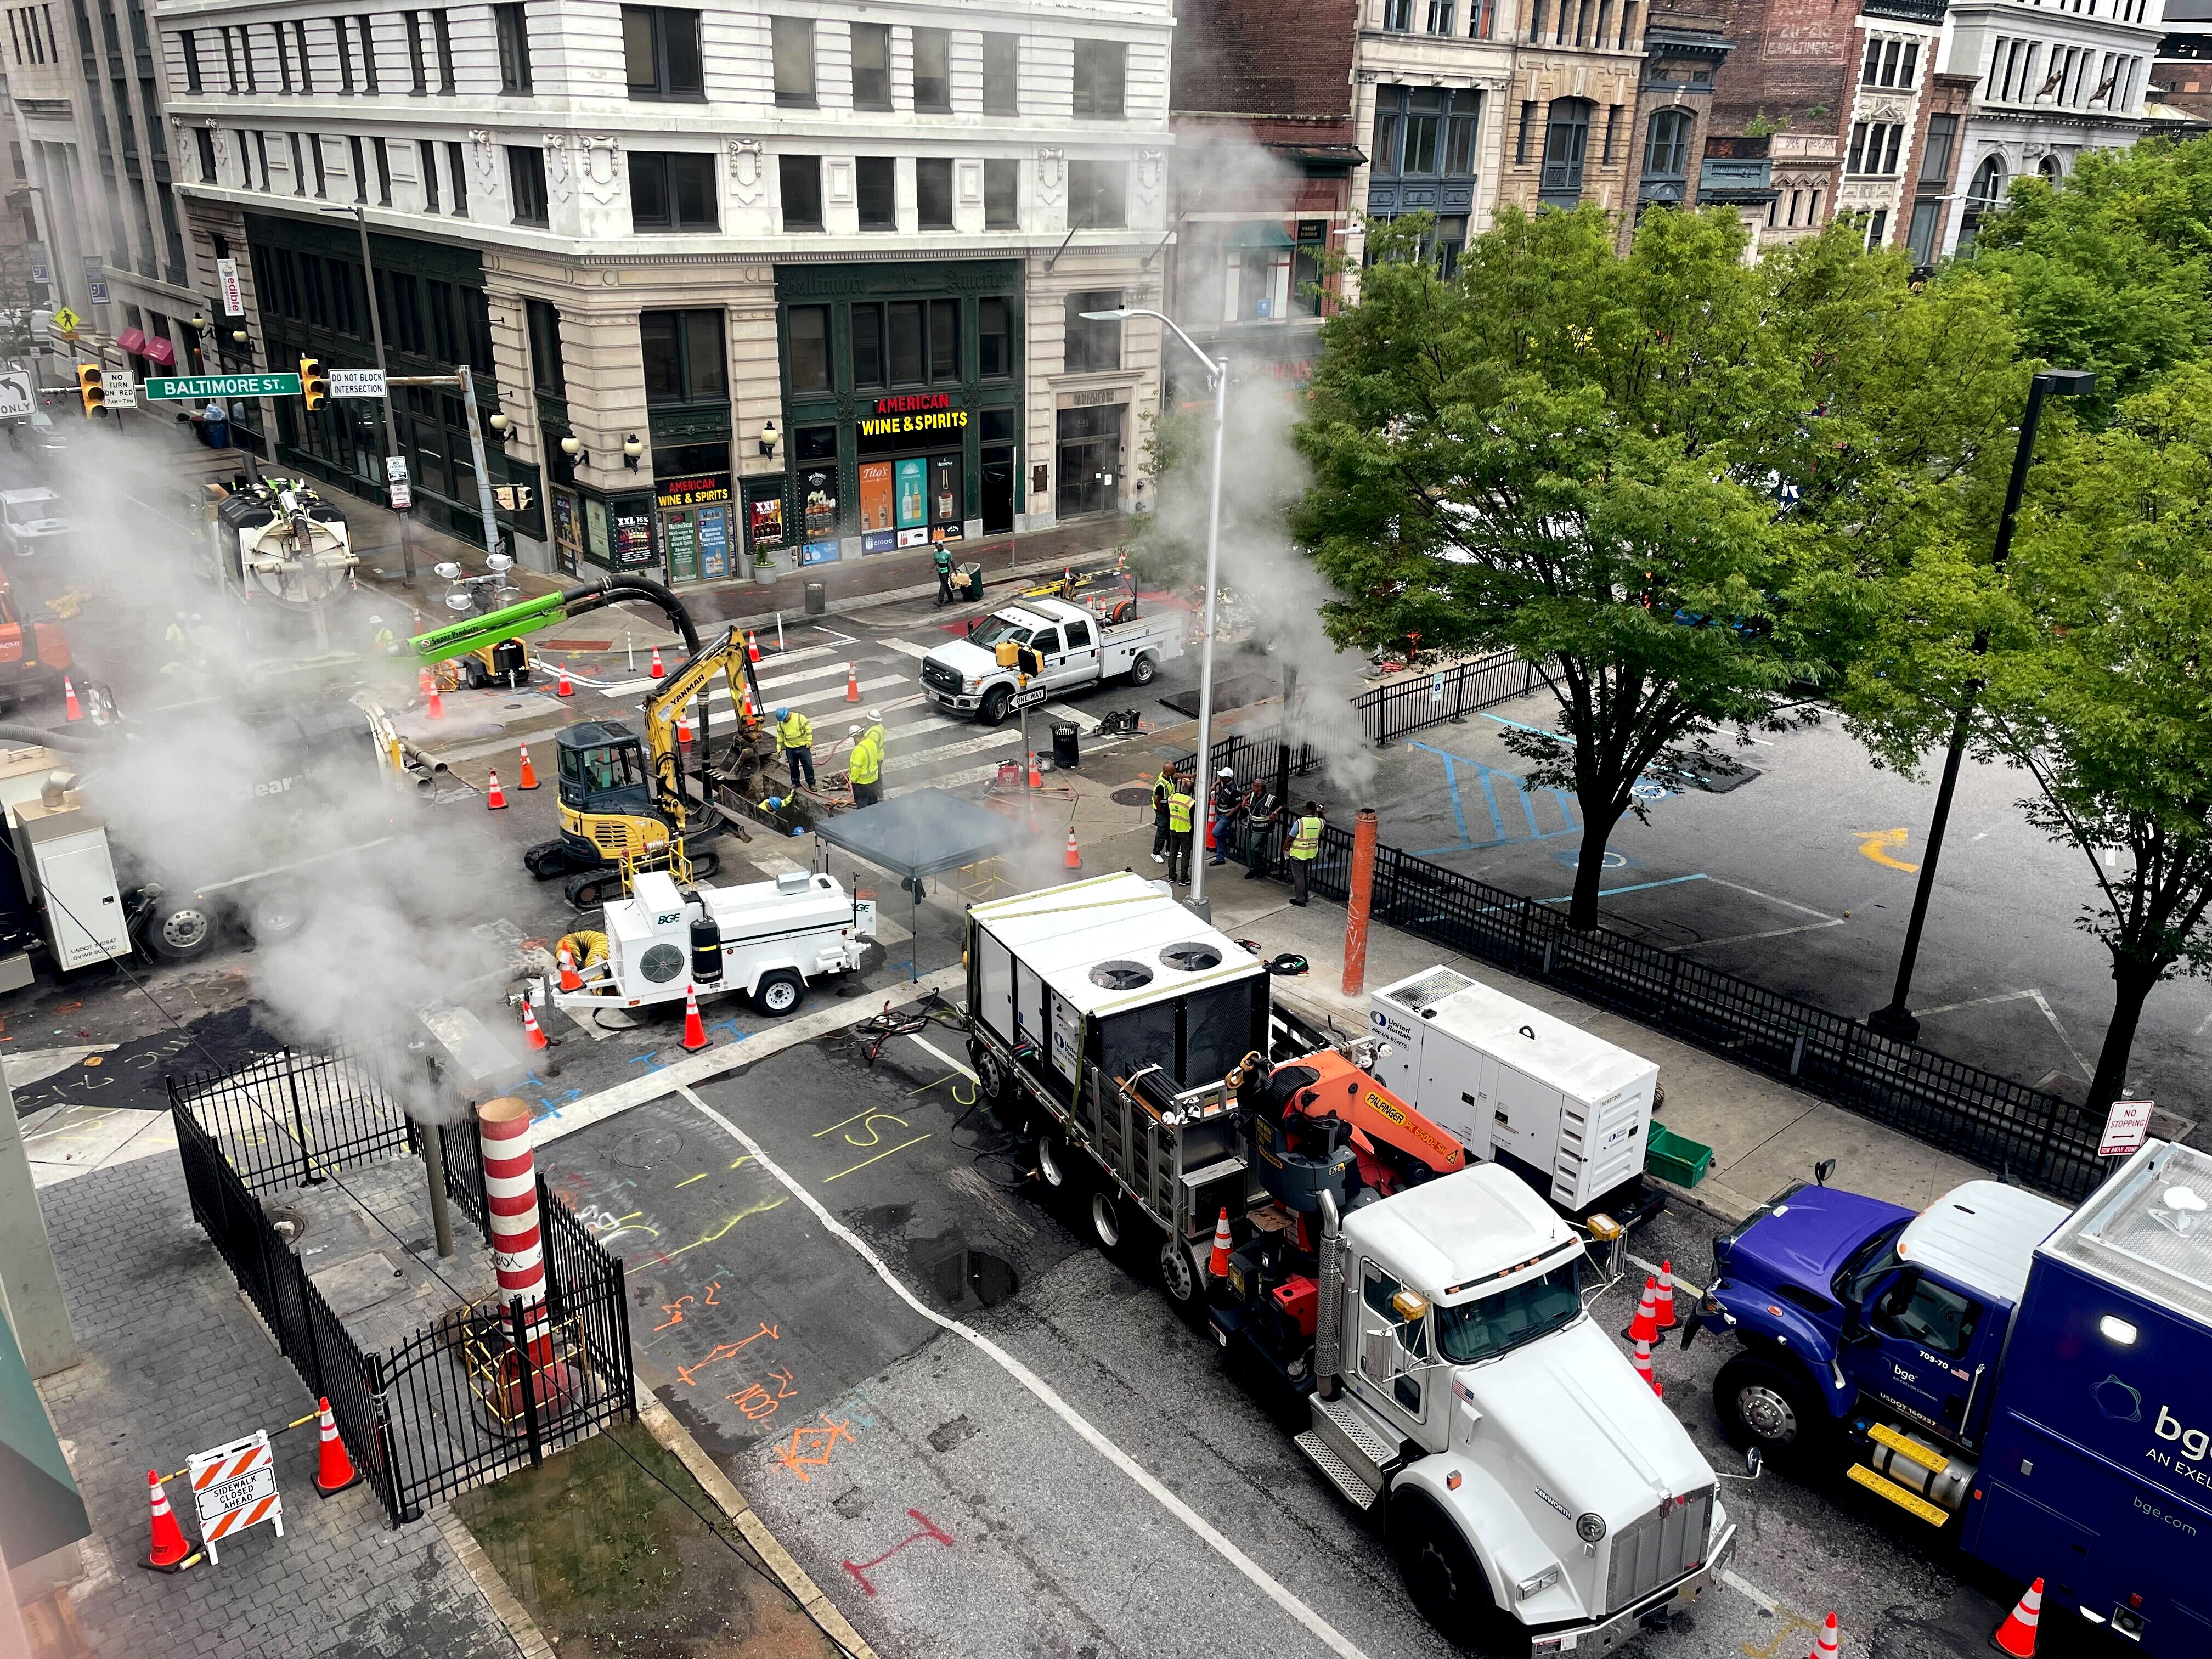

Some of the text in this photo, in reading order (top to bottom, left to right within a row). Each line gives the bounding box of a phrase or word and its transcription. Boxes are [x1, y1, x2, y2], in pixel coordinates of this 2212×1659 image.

[228, 278, 240, 311] edible
[360, 373, 382, 381] BLOCK
[164, 379, 284, 396] BALTIMORE ST.
[335, 385, 383, 394] INTERSECTION
[1, 403, 31, 414] ONLY
[878, 393, 949, 414] AMERICAN
[862, 418, 900, 436] WINE
[863, 466, 888, 479] Tito's
[669, 478, 715, 493] AMERICAN
[658, 489, 728, 506] WINE & SPIRITS
[756, 500, 777, 512] XXL
[617, 517, 636, 526] XXL
[669, 522, 693, 530] Heineken
[673, 573, 697, 582] Heineken
[432, 635, 450, 644] Super
[452, 626, 479, 638] Products
[671, 674, 705, 705] YANMAR
[1017, 690, 1043, 704] ONE WAY
[658, 913, 680, 924] BGE
[71, 944, 92, 954] USDOT
[73, 952, 93, 960] GVWR
[1387, 1024, 1412, 1041] Rentals
[1388, 1018, 1410, 1034] United
[1372, 1028, 1408, 1048] 800-UR-RENTS
[1065, 1041, 1078, 1057] Unite
[1367, 1093, 1404, 1124] PALFINGER
[1405, 1121, 1416, 1132] PK
[2110, 1119, 2145, 1128] STOPPING
[1920, 1350, 1948, 1369] 709-70
[1894, 1364, 1915, 1382] bge
[1900, 1379, 1916, 1391] EXELON
[1917, 1389, 1938, 1402] COMPANY
[1880, 1392, 1936, 1426] USDOT 160257
[2154, 1405, 2212, 1461] bg
[2146, 1448, 2170, 1466] AN
[214, 1475, 257, 1497] SIDEWALK
[219, 1485, 253, 1503] CLOSED
[224, 1493, 252, 1510] AHEAD
[1535, 1486, 1571, 1519] KENWORTH
[2134, 1496, 2197, 1537] bge.com
